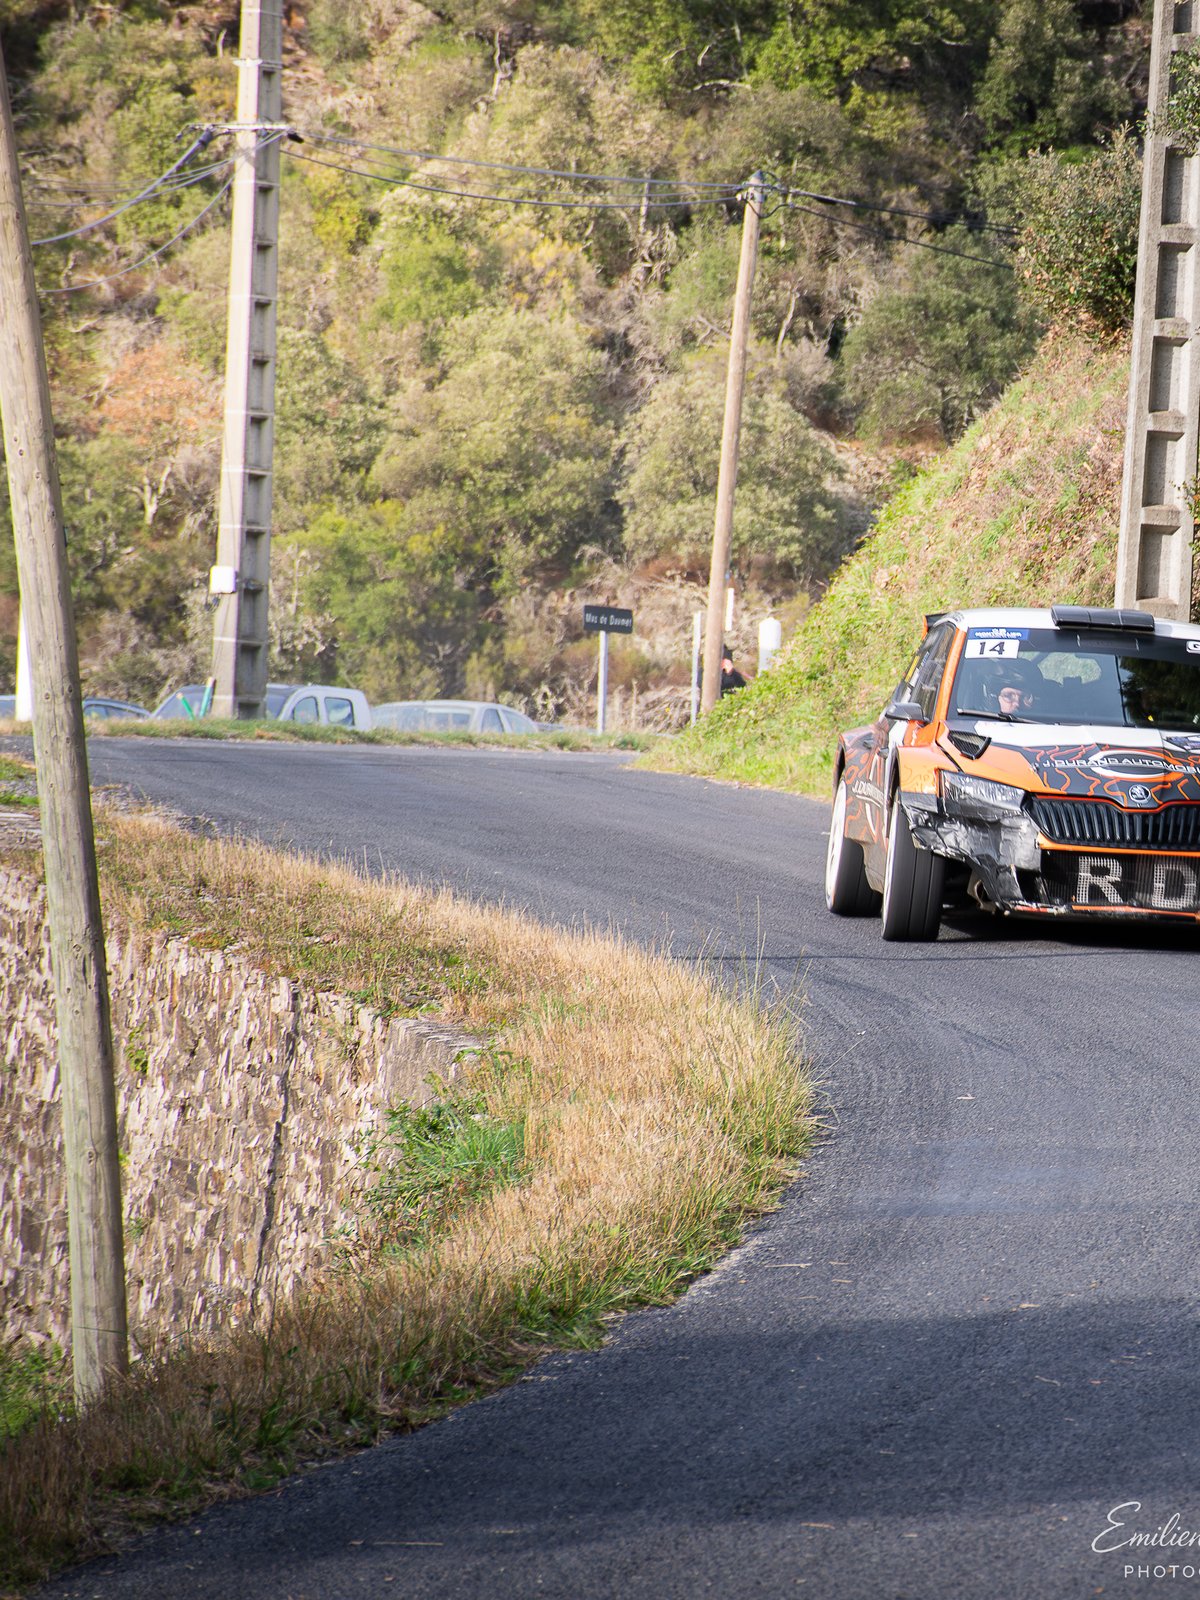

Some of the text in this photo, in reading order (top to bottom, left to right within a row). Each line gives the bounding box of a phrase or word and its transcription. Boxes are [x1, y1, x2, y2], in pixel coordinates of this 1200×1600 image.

[585, 613, 598, 624] Mas
[600, 614, 608, 625] de
[979, 641, 1005, 656] 14
[1077, 855, 1198, 908] R D
